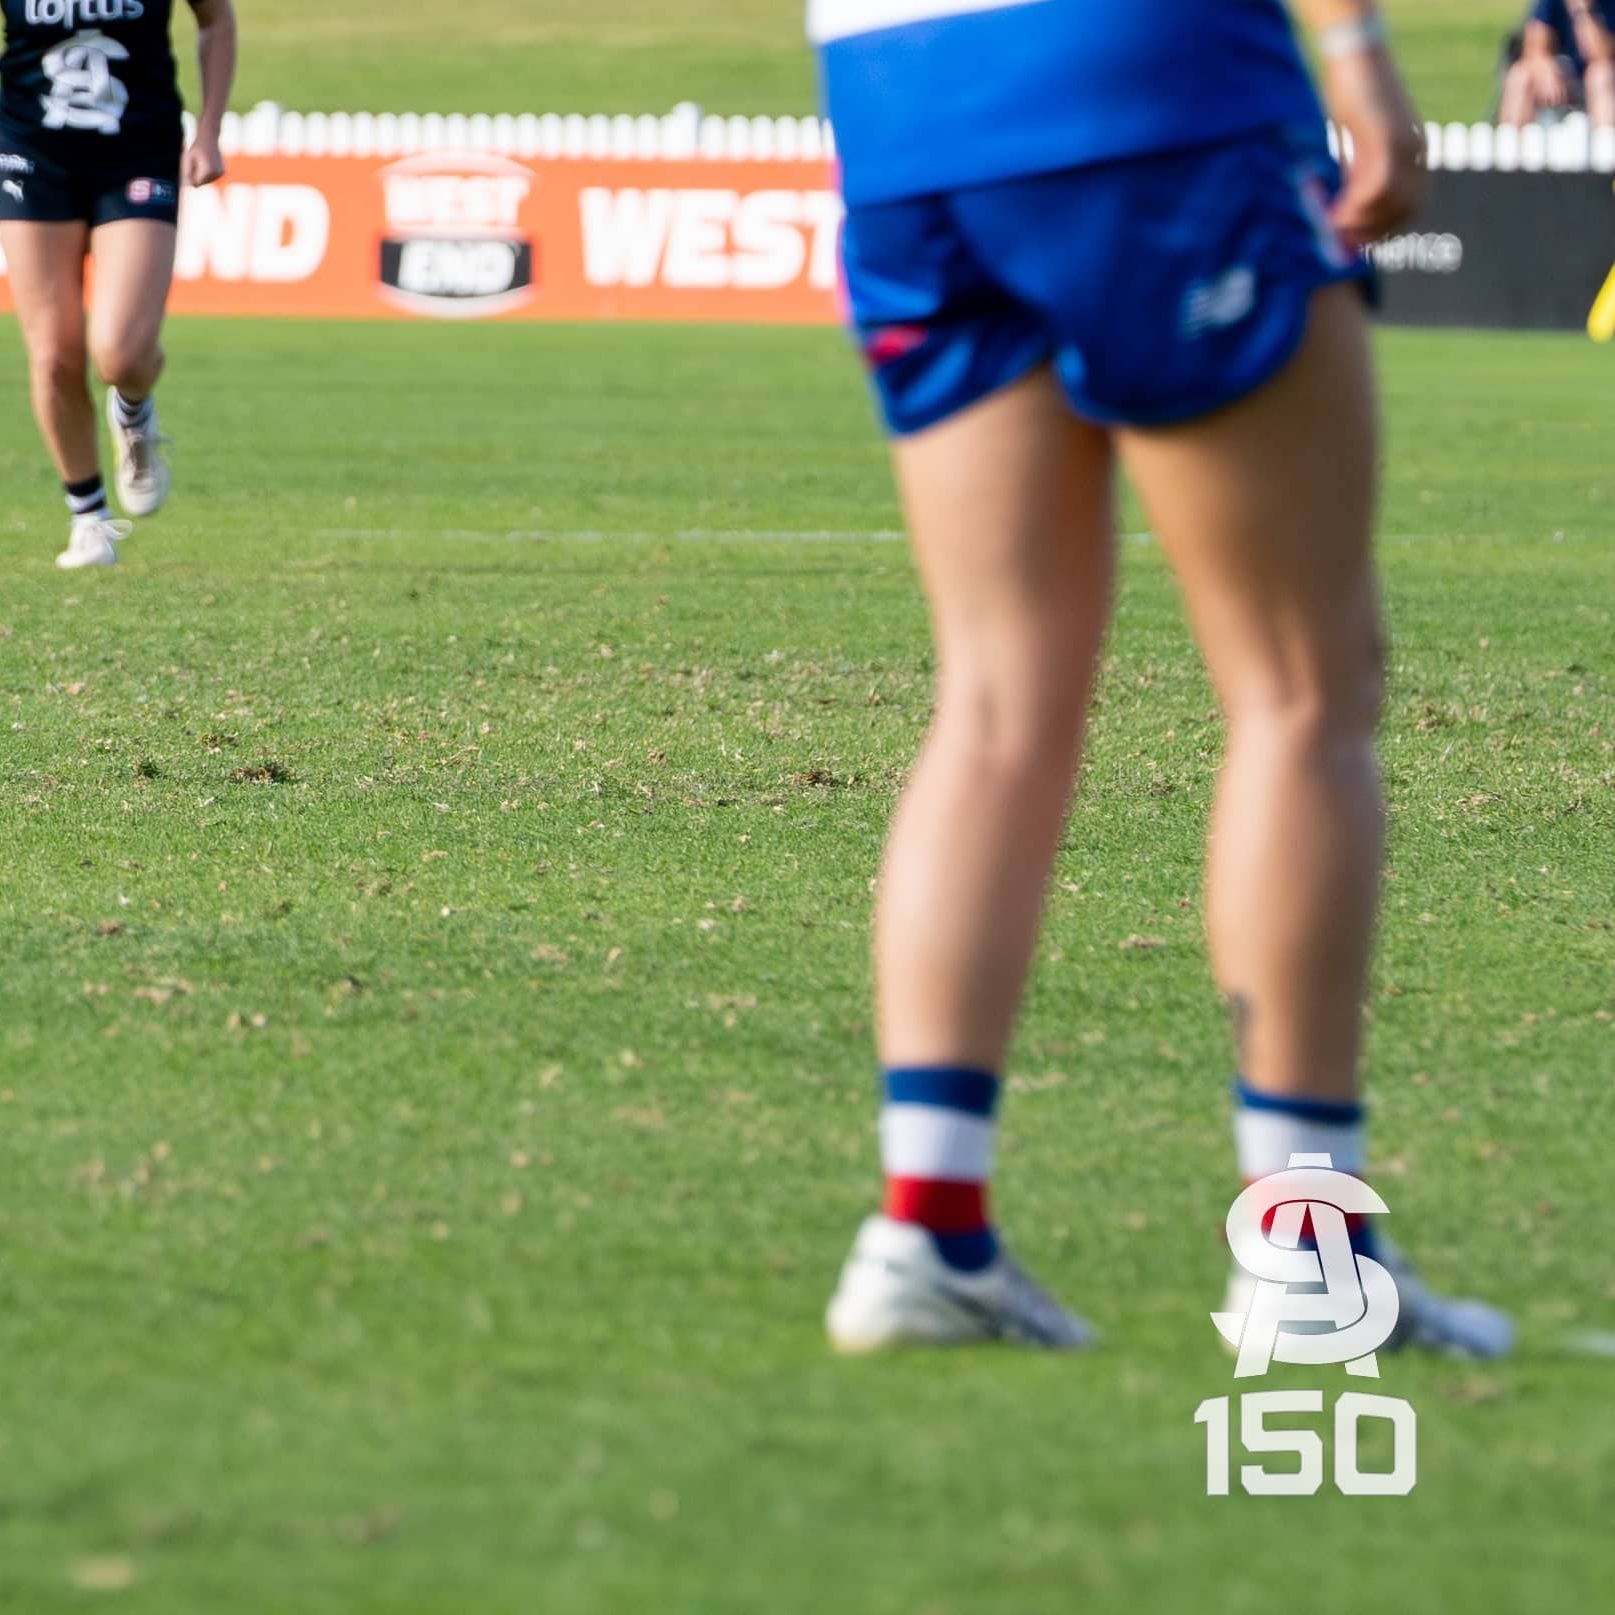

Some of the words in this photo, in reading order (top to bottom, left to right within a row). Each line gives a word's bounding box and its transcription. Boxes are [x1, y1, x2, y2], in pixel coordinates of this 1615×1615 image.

[383, 175, 530, 227] WEST
[176, 182, 331, 283] ND
[398, 239, 516, 295] END
